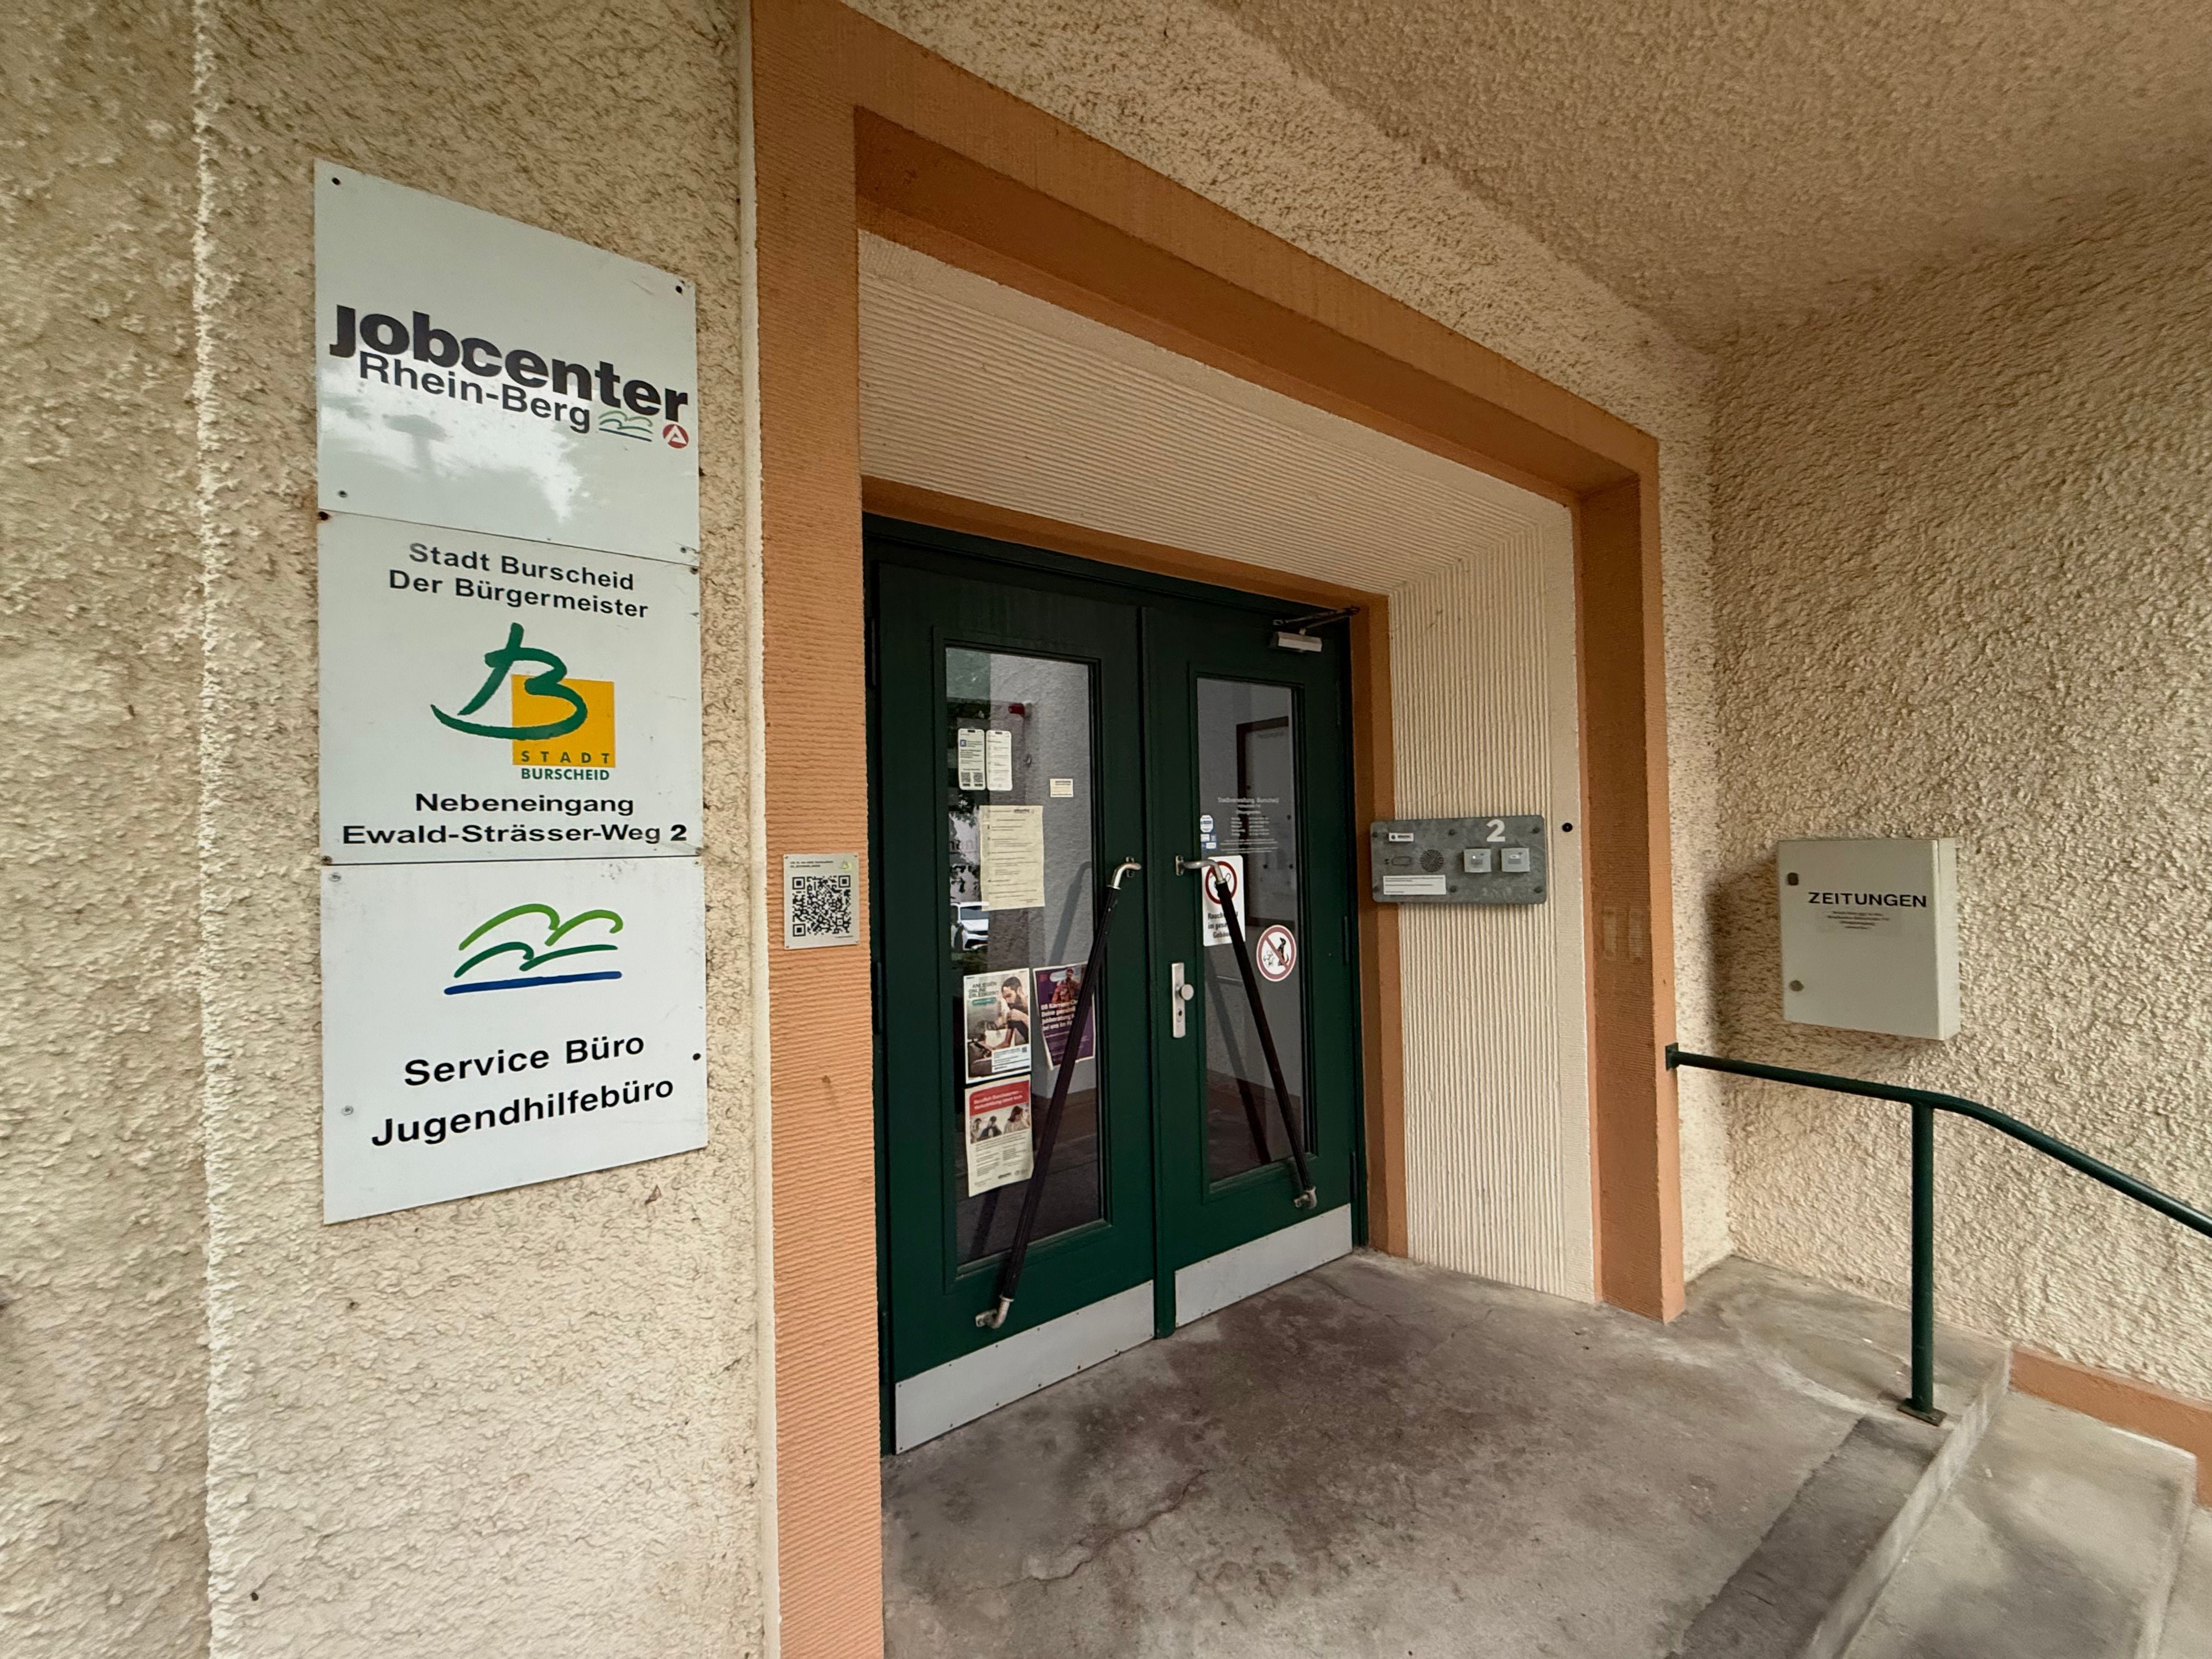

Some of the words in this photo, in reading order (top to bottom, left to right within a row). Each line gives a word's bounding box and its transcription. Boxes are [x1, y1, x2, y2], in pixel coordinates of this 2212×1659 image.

[329, 304, 688, 422] Jobcenter
[359, 351, 590, 434] Rhein-Berg
[409, 542, 490, 572] Stadt
[501, 555, 634, 591] Burscheid
[389, 569, 443, 594] Der
[455, 577, 649, 618] Bürgermeister
[521, 750, 611, 764] STADT
[521, 768, 610, 781] BURSCHEID
[416, 793, 634, 816] Nebeneingang
[343, 823, 660, 844] Ewald-Strässer-Weg
[670, 823, 687, 841] 2
[1486, 819, 1506, 842] 2
[1808, 891, 1927, 908] ZEITUNGEN
[405, 1048, 550, 1087] Service
[566, 1036, 645, 1064] Büro
[372, 1079, 674, 1146] Jugendhilfebüro
